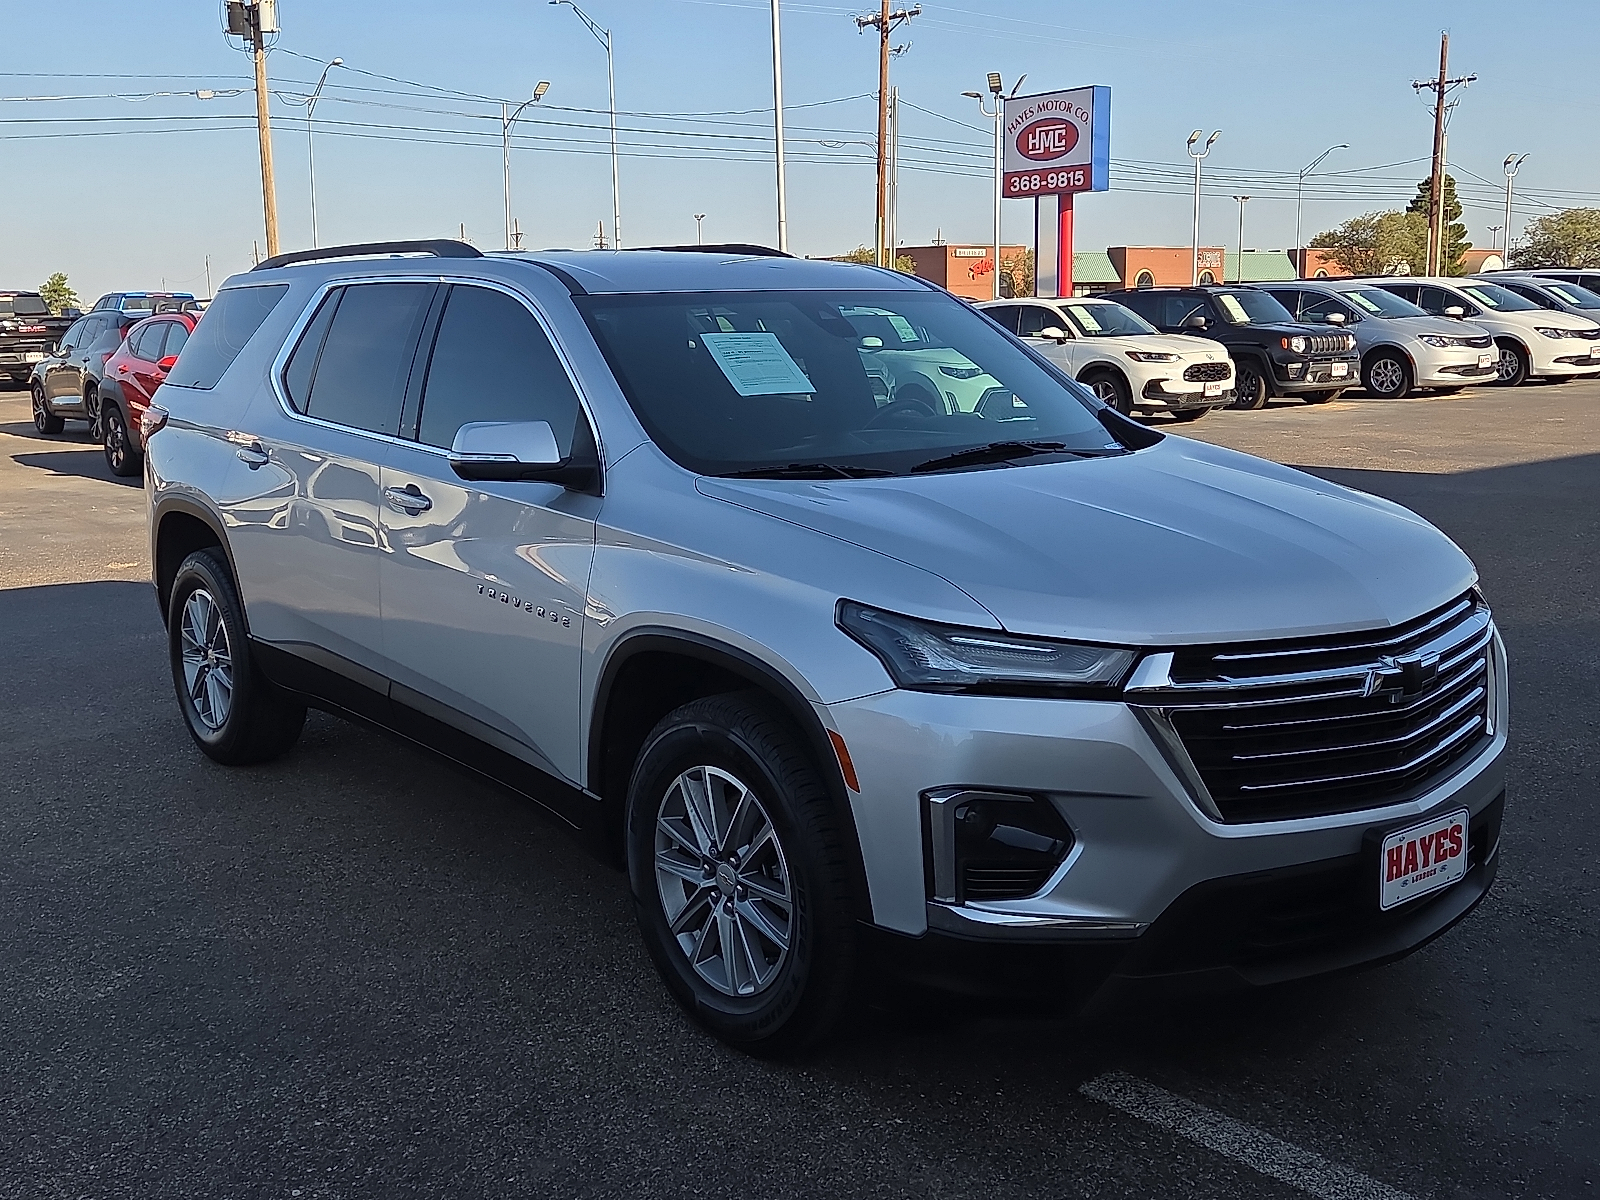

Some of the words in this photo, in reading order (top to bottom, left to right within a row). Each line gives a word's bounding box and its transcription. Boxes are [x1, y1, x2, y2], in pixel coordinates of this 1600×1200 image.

[1007, 106, 1035, 135] HAYES
[1036, 100, 1073, 114] MOTOR
[1074, 107, 1090, 126] CO.
[1028, 124, 1067, 155] HMC
[1010, 170, 1084, 192] 368-9815
[477, 583, 571, 629] TRAVERSE
[1386, 823, 1463, 883] HAYES
